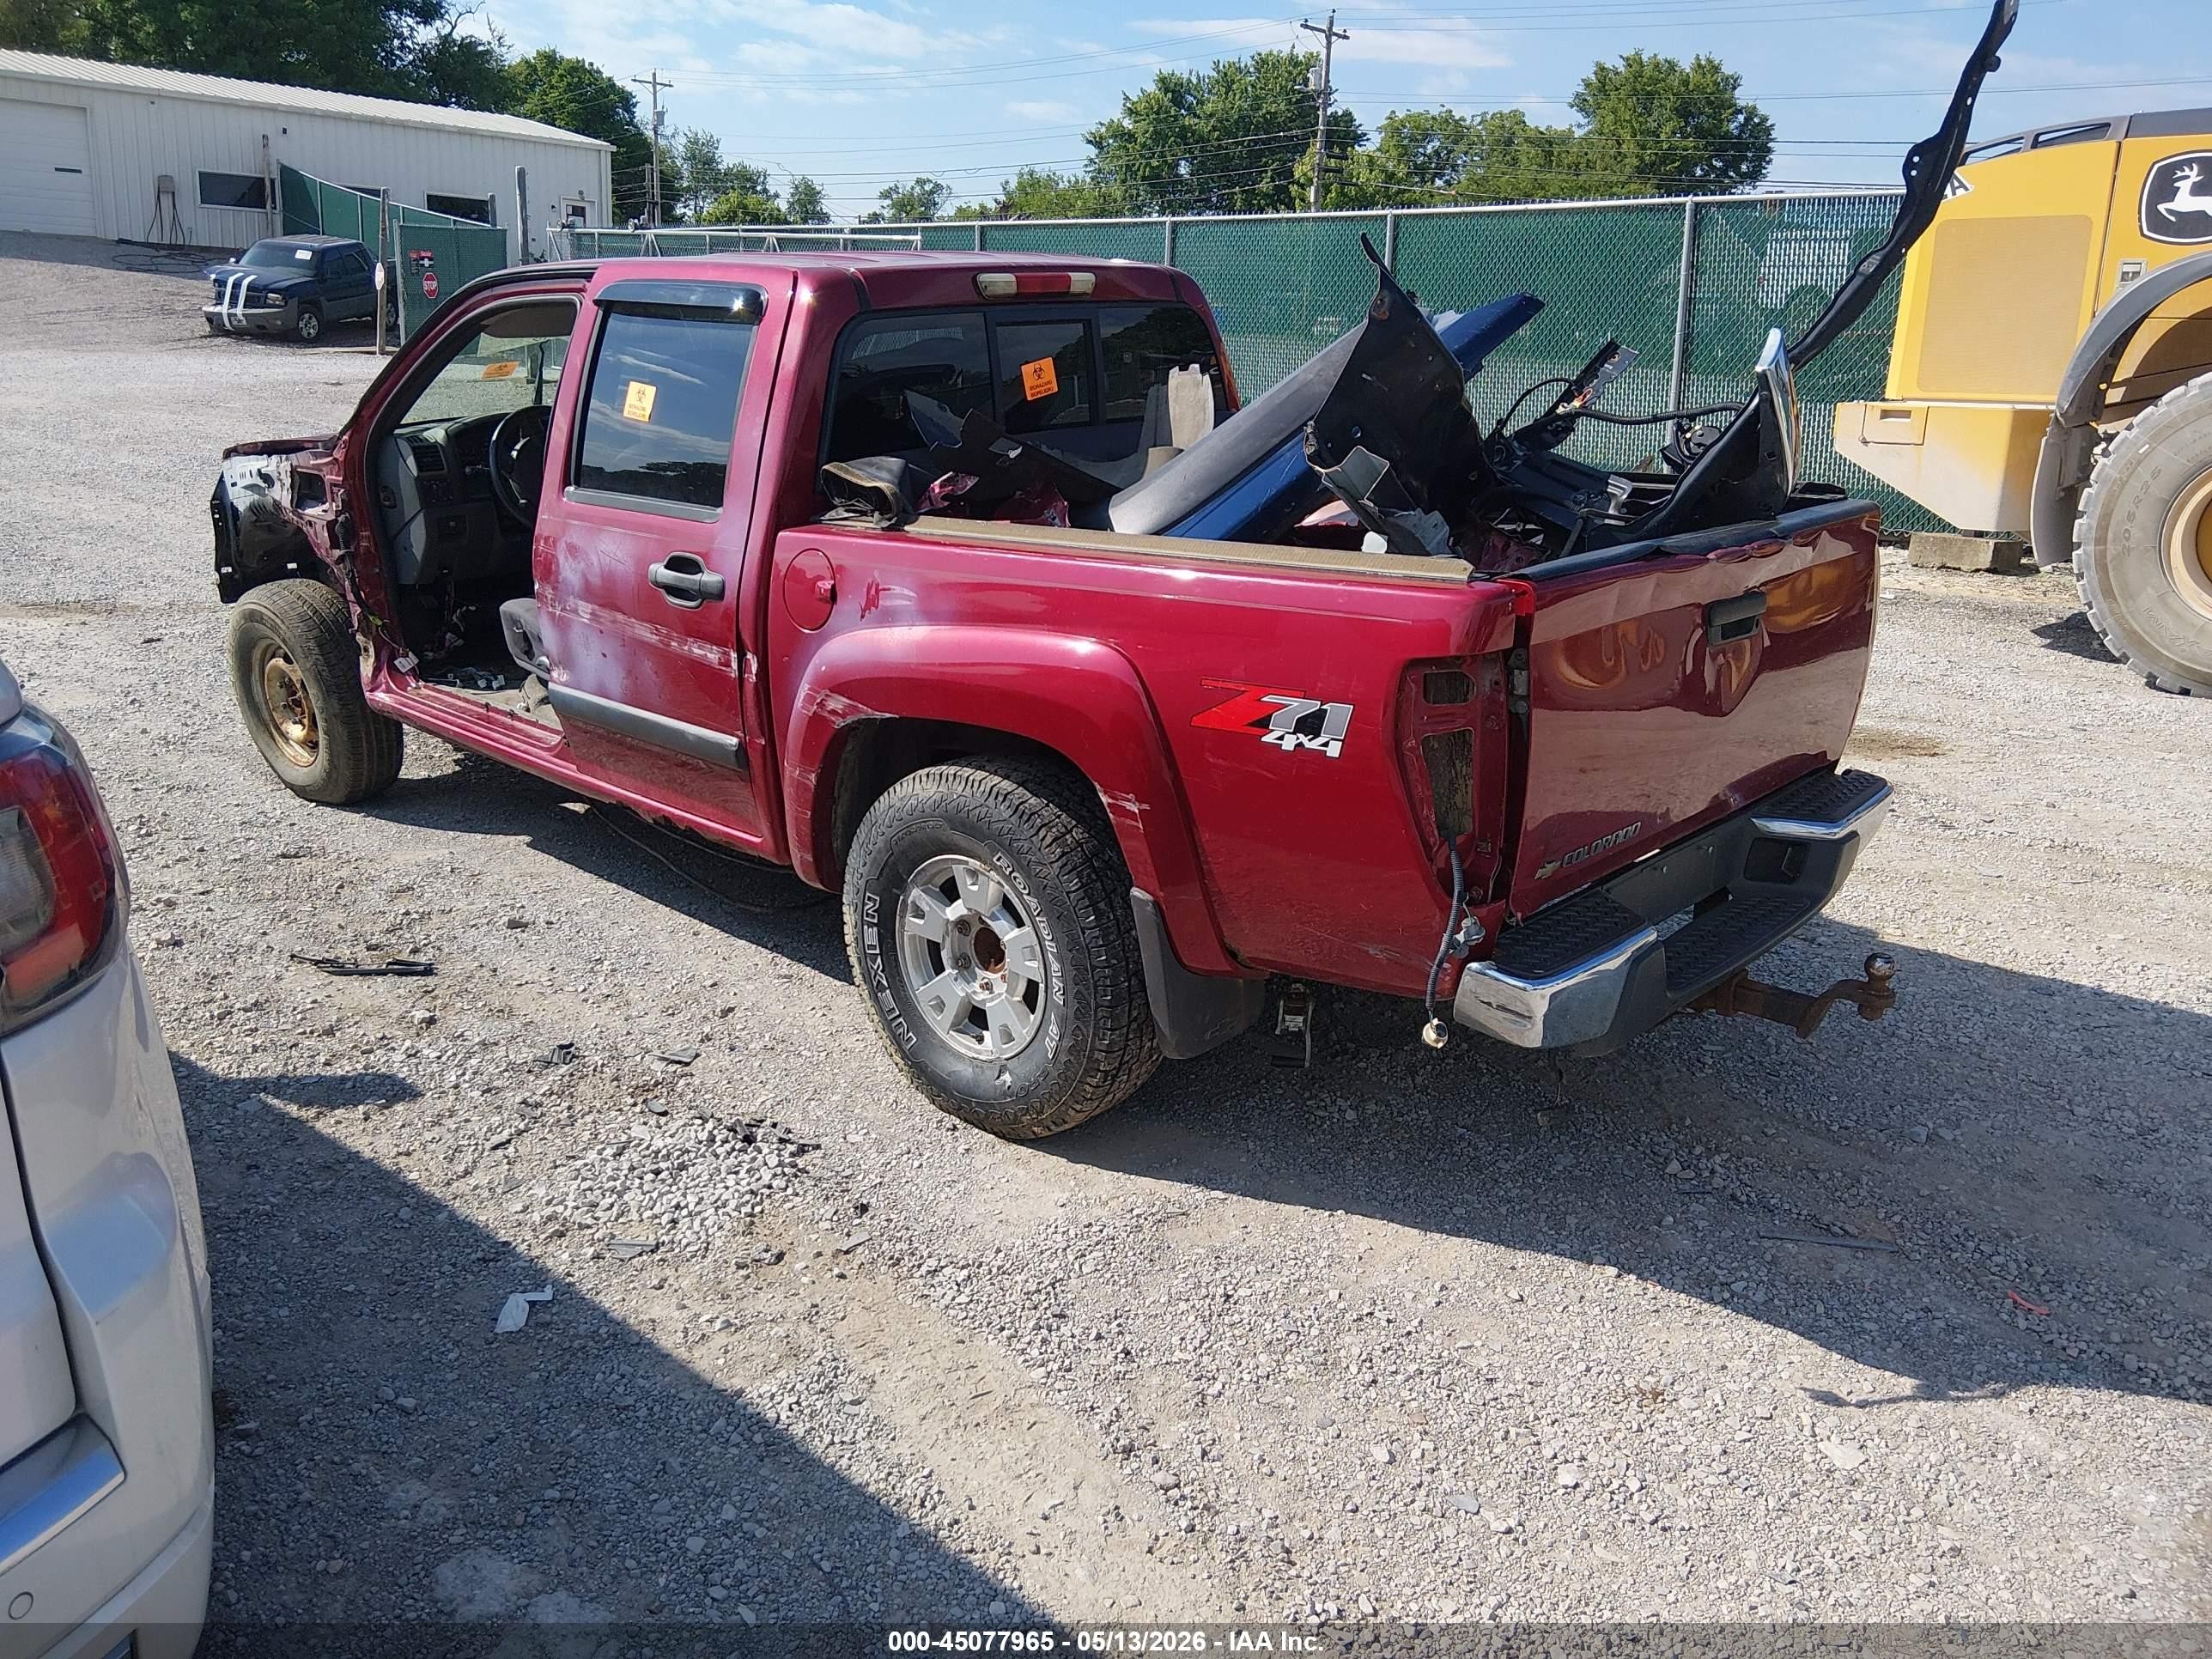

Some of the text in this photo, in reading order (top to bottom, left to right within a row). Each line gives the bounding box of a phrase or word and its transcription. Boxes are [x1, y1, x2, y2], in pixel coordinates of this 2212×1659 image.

[423, 280, 438, 292] STOP
[1190, 678, 1355, 740] Z71
[1562, 821, 1642, 867] COLORADO
[862, 892, 918, 1052] NEXEN
[993, 852, 1065, 1006] ROADIAN
[1044, 1012, 1062, 1060] AT
